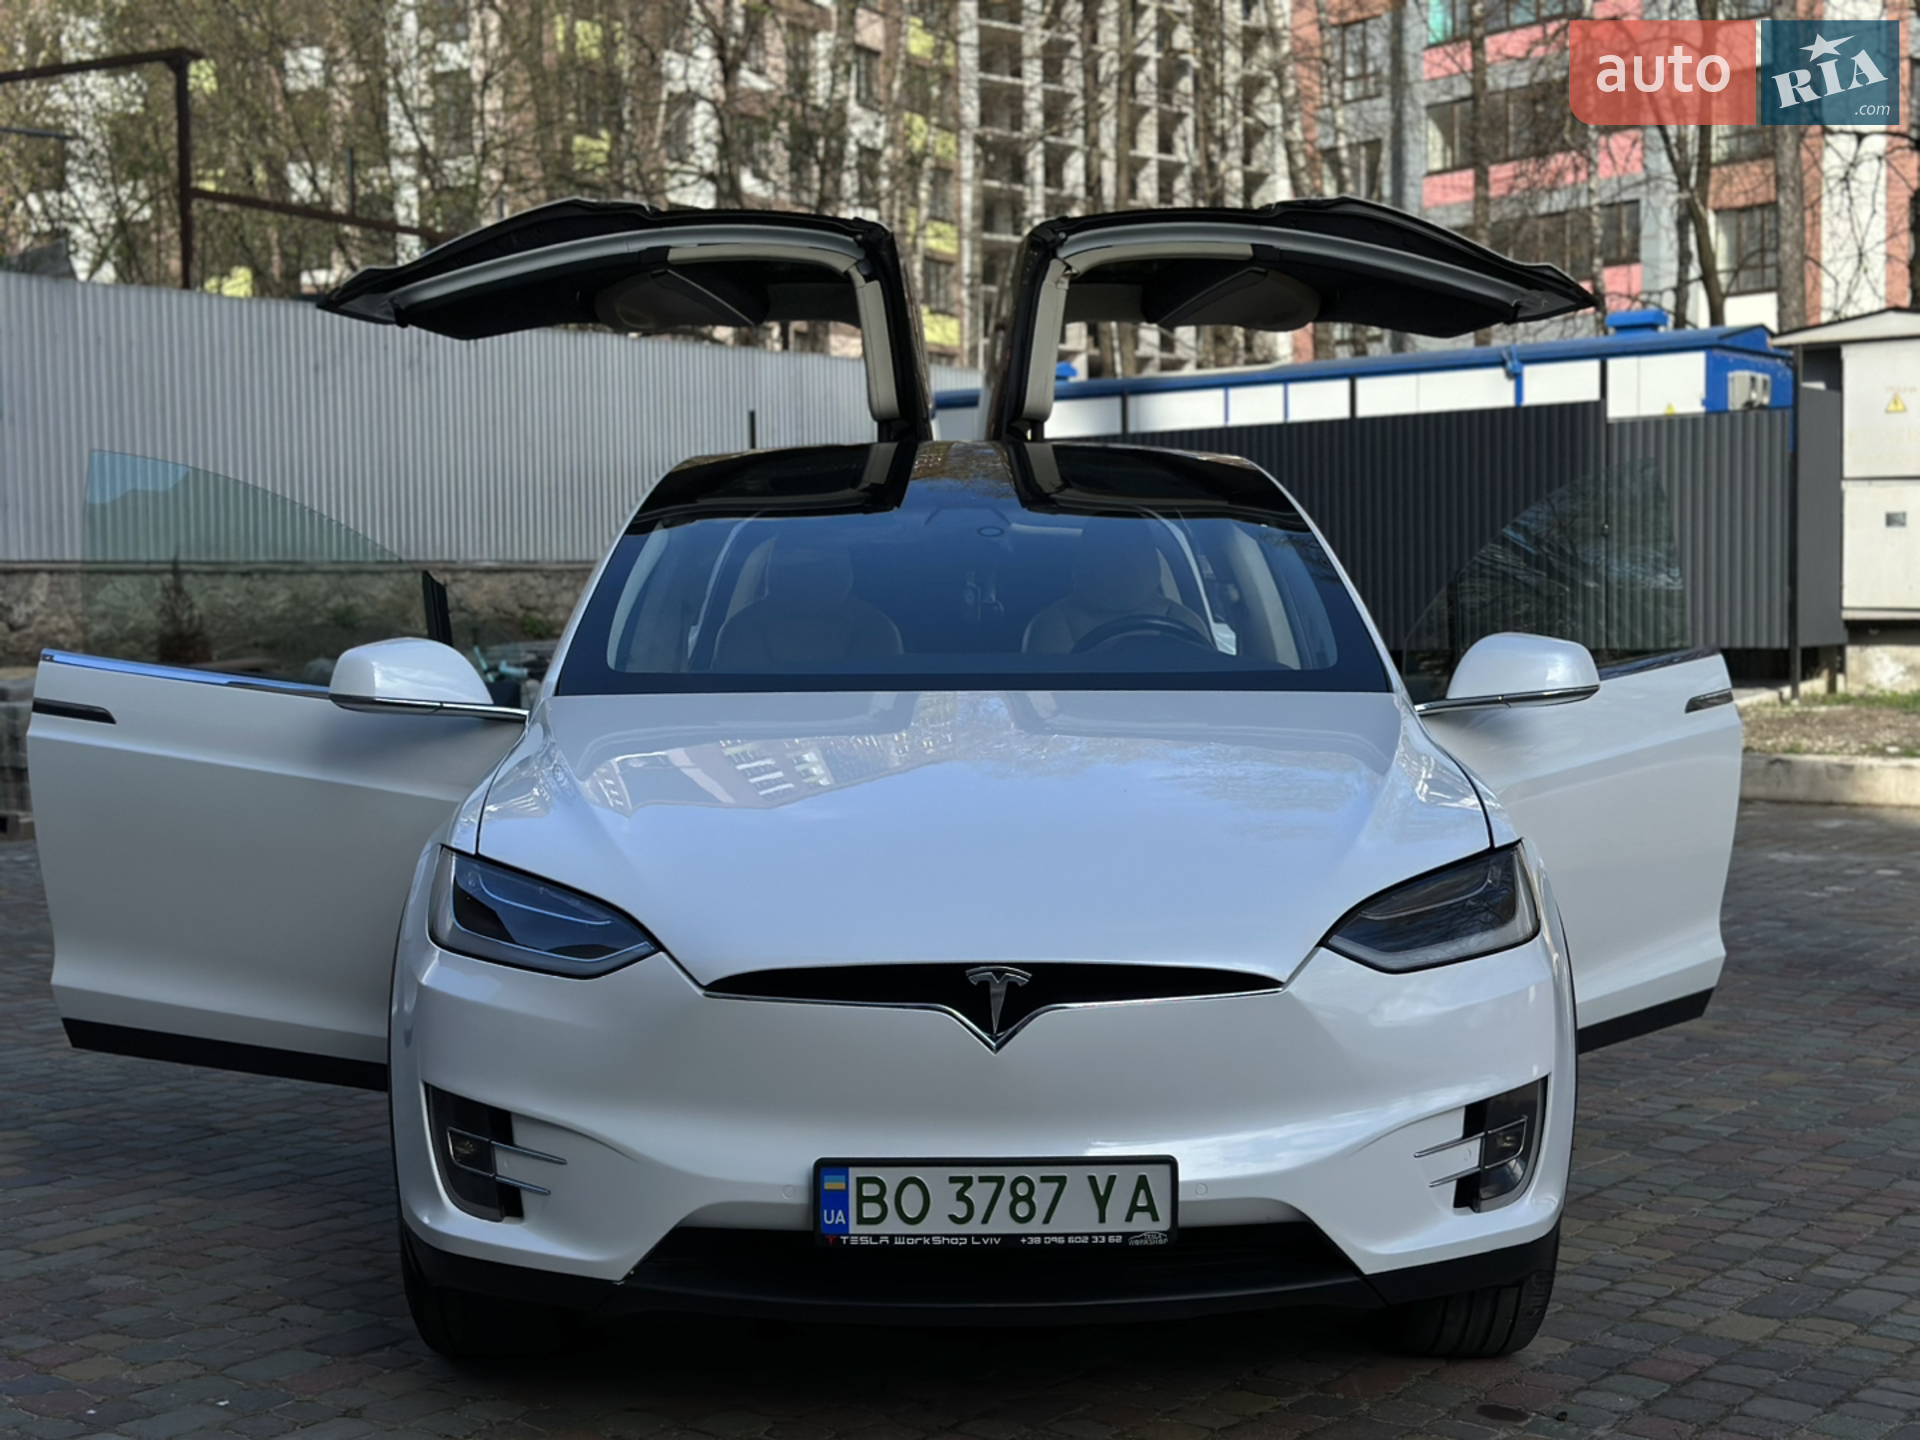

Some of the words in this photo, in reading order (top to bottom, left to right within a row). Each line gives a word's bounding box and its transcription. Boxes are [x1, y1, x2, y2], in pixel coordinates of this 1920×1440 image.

[855, 1175, 931, 1225] BO
[948, 1174, 1067, 1225] 3787
[1087, 1173, 1160, 1224] YA
[823, 1209, 846, 1225] UA
[839, 1235, 890, 1246] TESLA
